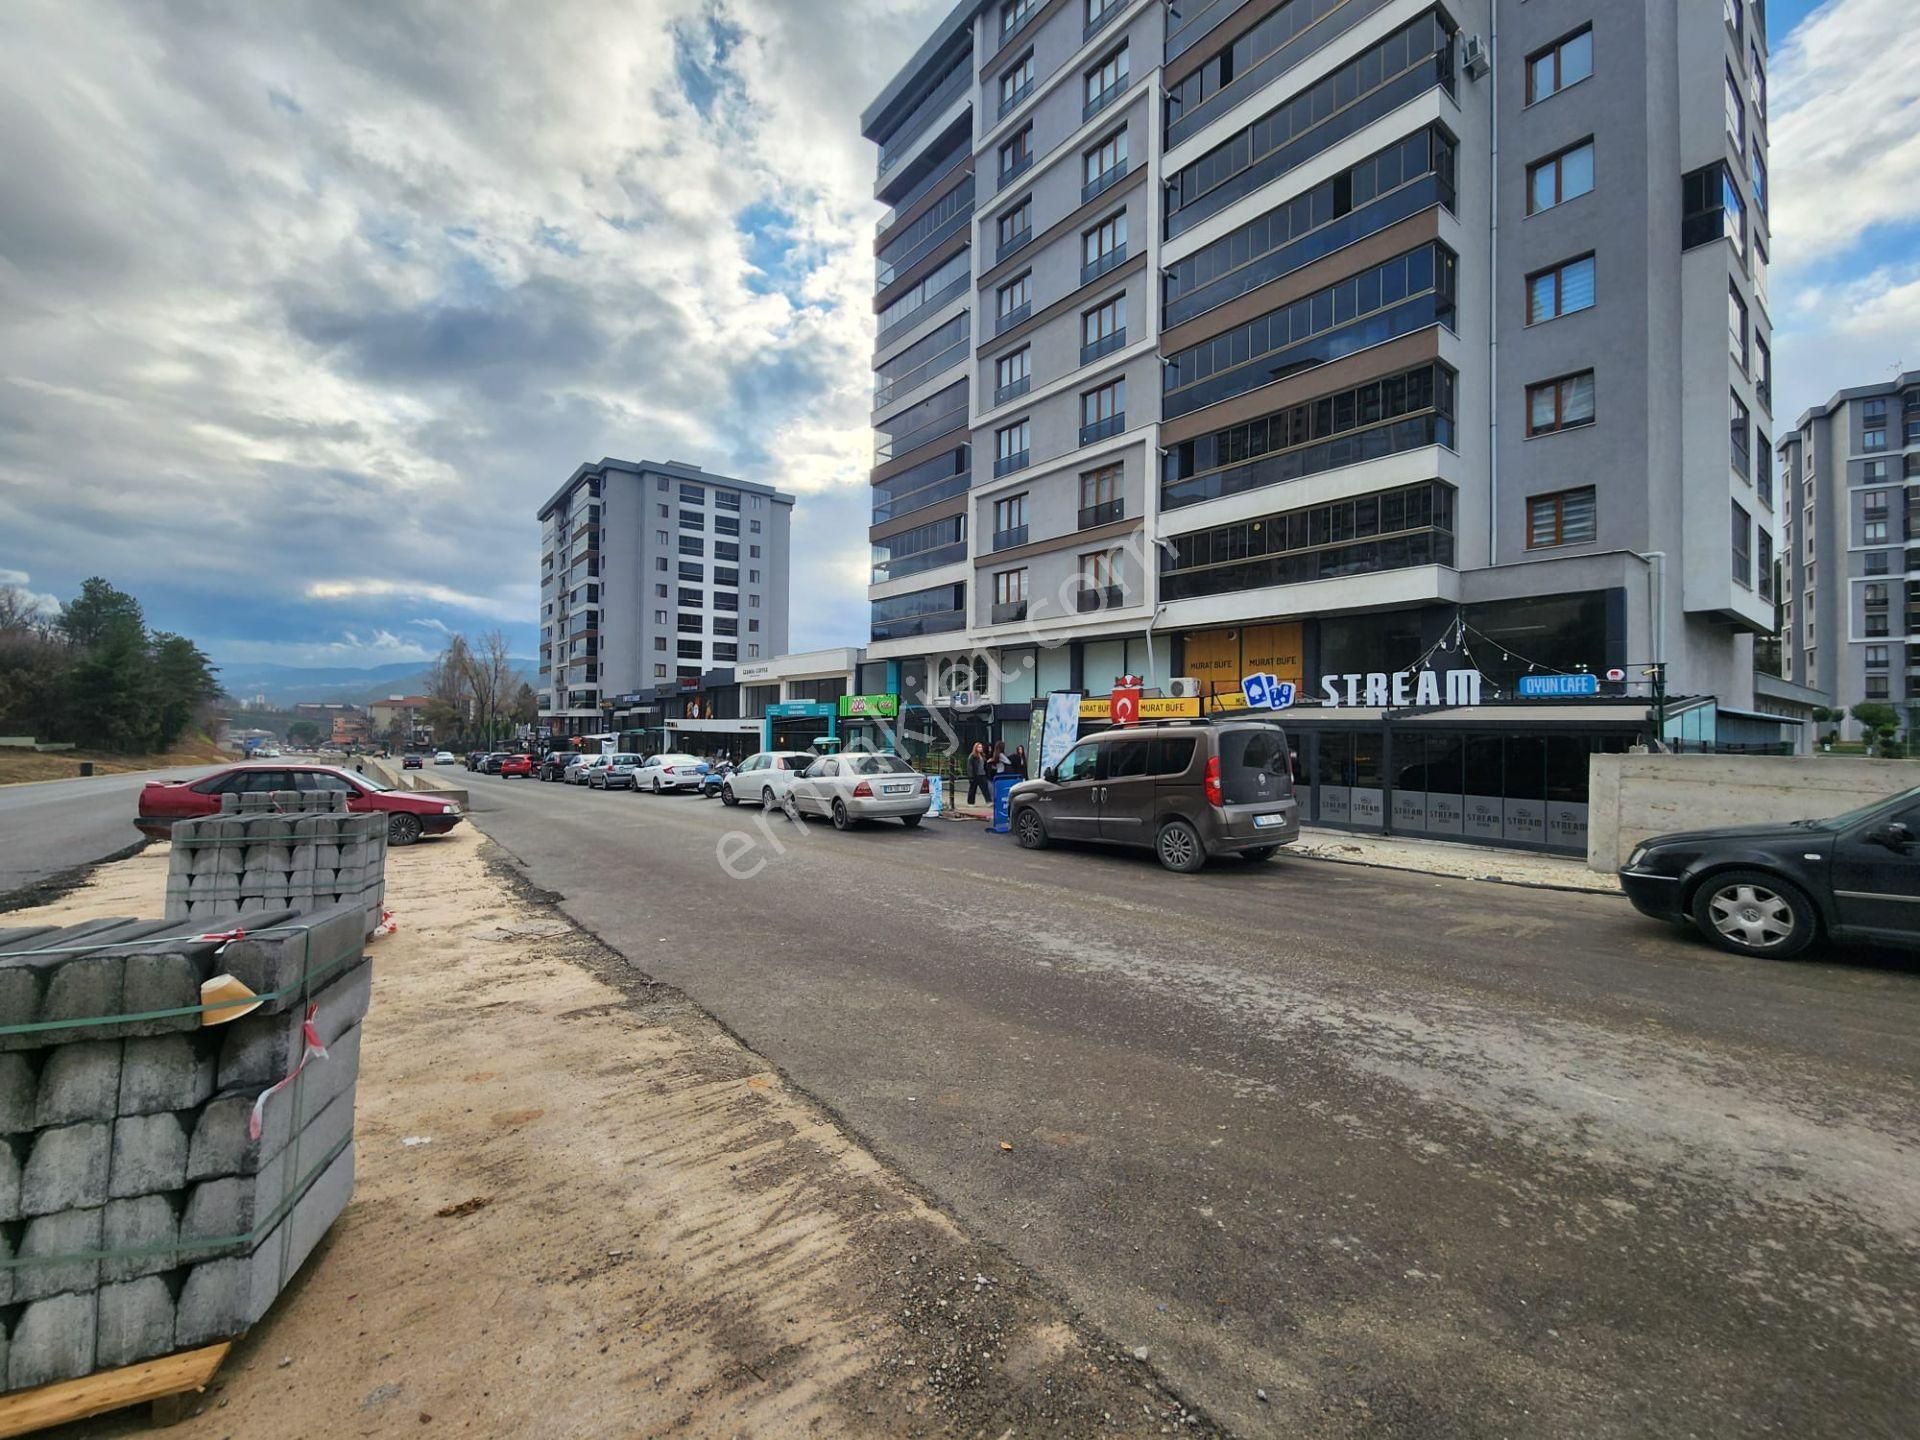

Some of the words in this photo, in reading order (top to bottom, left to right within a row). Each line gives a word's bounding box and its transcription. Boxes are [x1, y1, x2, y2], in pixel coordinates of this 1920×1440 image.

[1190, 661, 1213, 670] MURAT
[1249, 657, 1275, 667] MURAT
[1321, 669, 1481, 707] STREAM
[1526, 678, 1558, 694] OYUN
[1560, 677, 1588, 693] CAFE
[1140, 703, 1165, 712] MURAT
